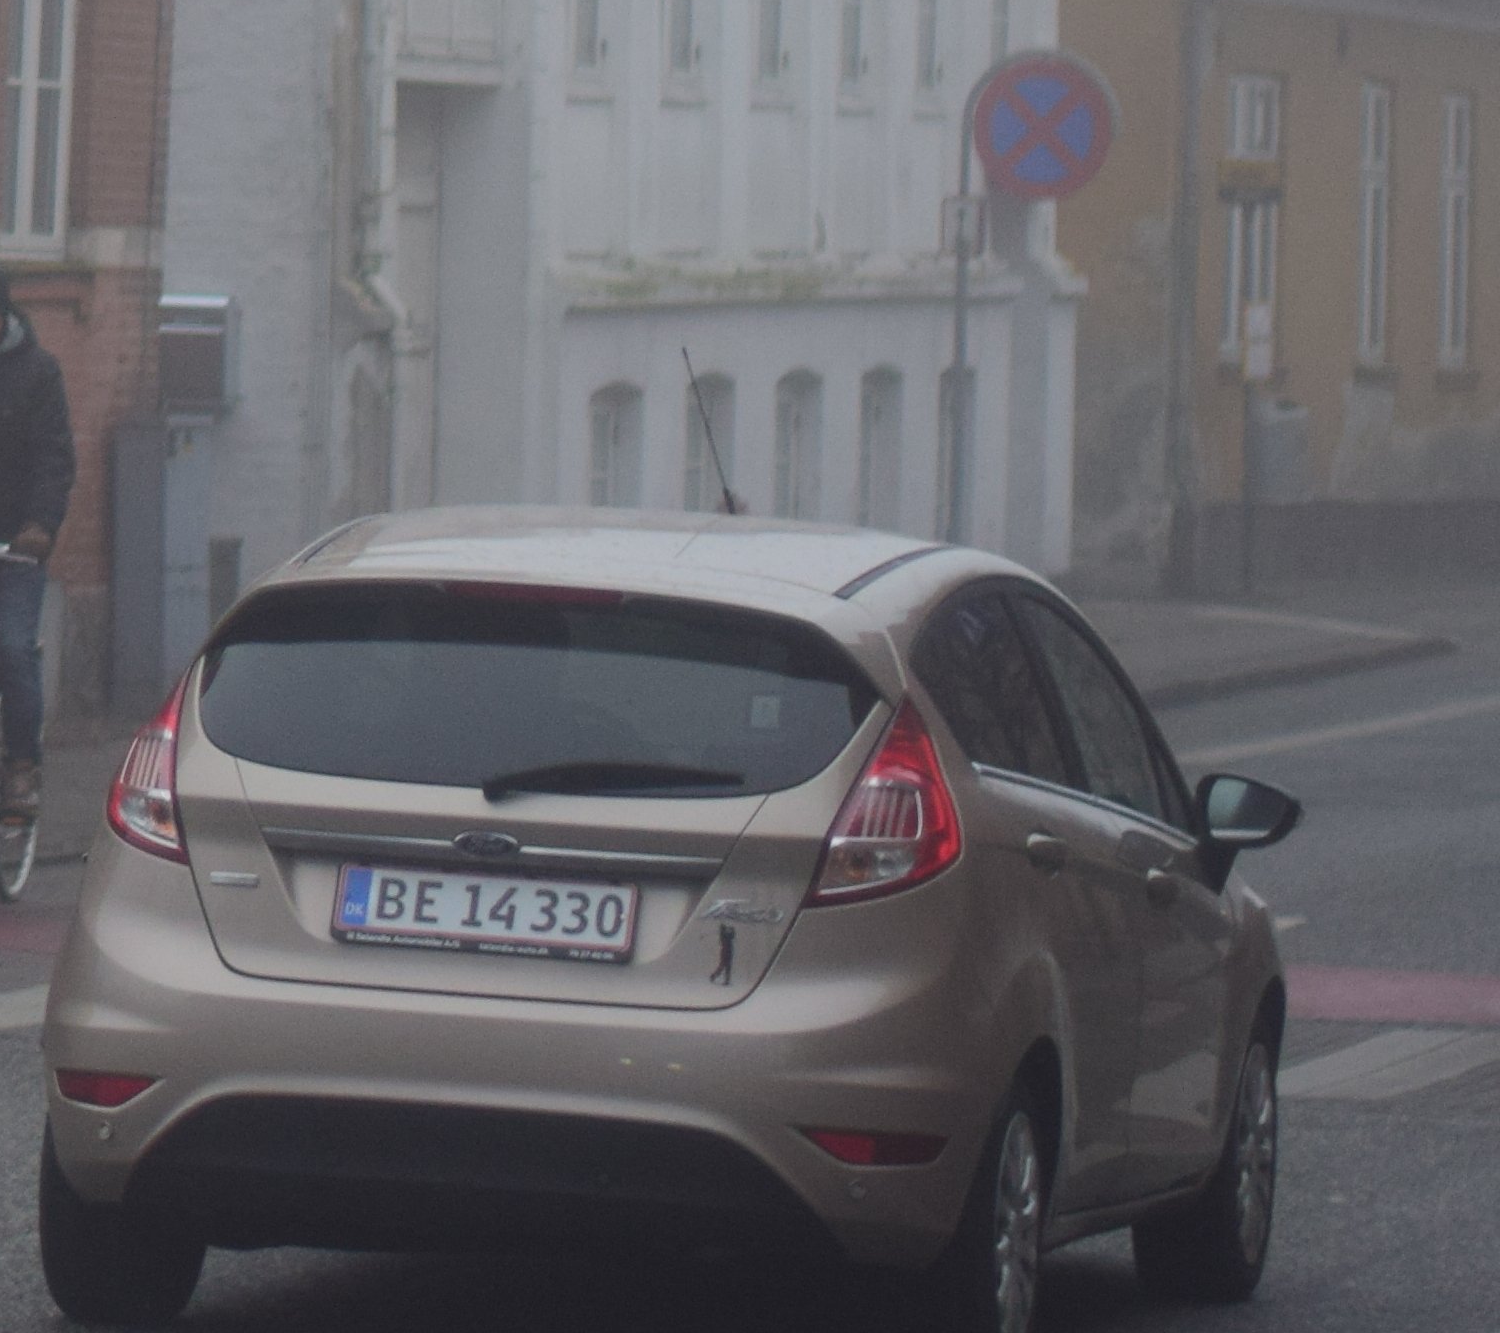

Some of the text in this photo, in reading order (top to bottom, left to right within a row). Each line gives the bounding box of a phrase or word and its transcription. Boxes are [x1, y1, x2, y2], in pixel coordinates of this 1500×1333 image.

[345, 902, 365, 916] DK
[375, 877, 625, 937] BE 14 330
